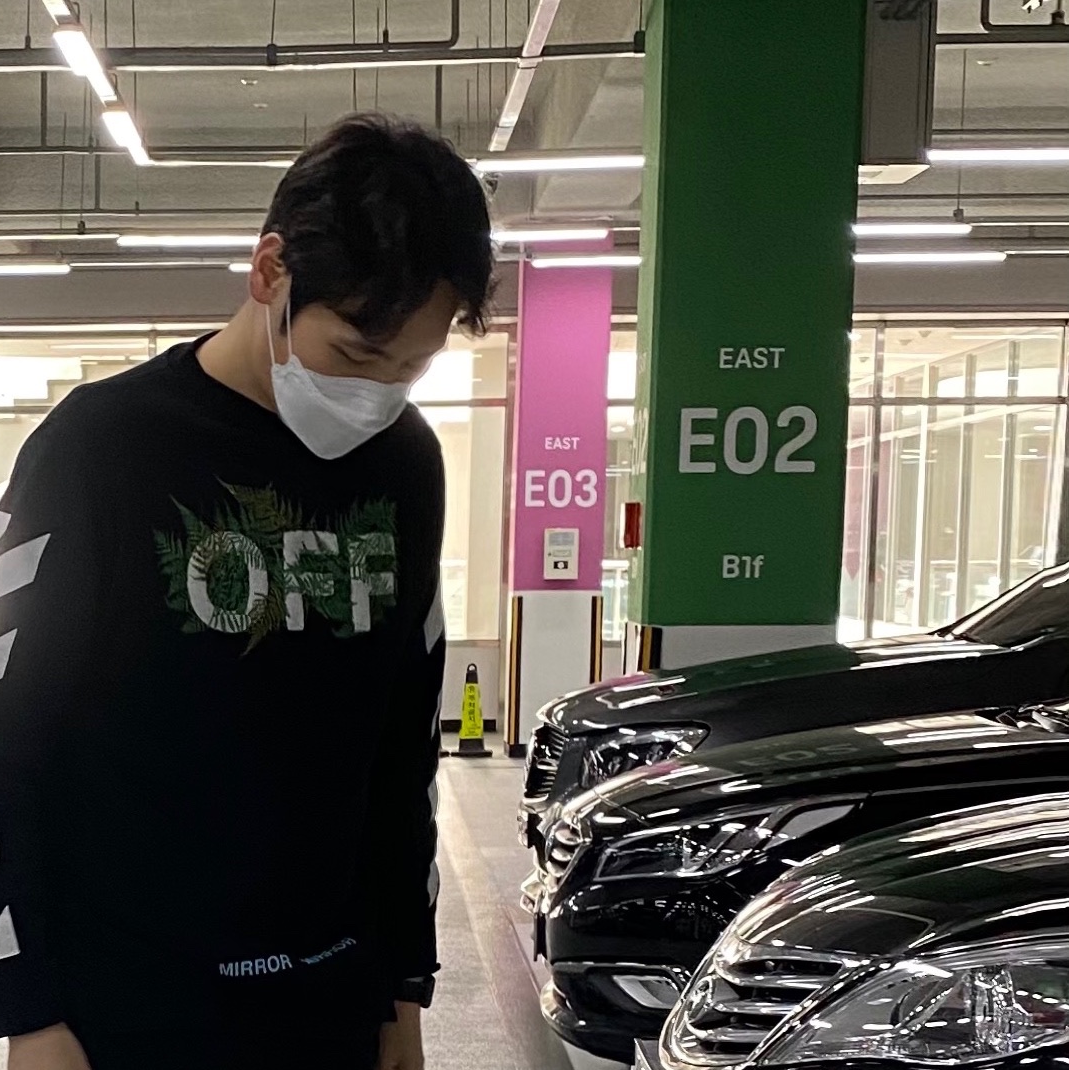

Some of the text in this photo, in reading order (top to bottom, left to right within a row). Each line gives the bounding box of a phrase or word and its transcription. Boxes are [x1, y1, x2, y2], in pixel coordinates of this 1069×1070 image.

[719, 347, 785, 369] EAST
[544, 437, 580, 450] EAST
[678, 405, 818, 475] E02
[524, 469, 598, 508] E03
[722, 555, 765, 579] B1f
[187, 529, 395, 633] OFF
[219, 953, 293, 977] MIRROR
